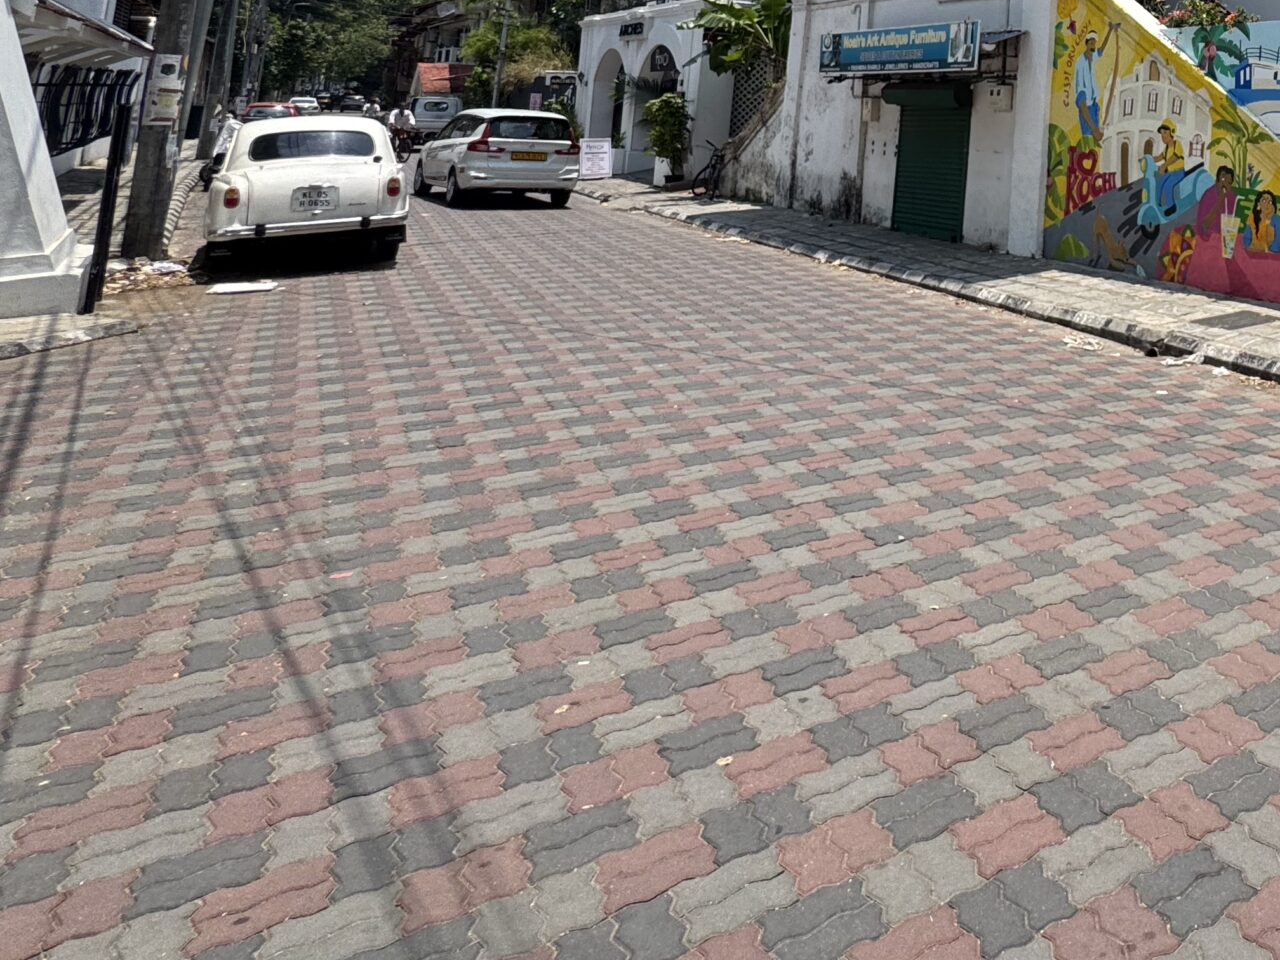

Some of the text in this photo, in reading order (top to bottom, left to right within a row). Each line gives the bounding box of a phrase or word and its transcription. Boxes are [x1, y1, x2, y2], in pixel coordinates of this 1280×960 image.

[909, 29, 947, 45] Furniture
[302, 191, 313, 199] KL
[1064, 167, 1117, 217] KOCHI
